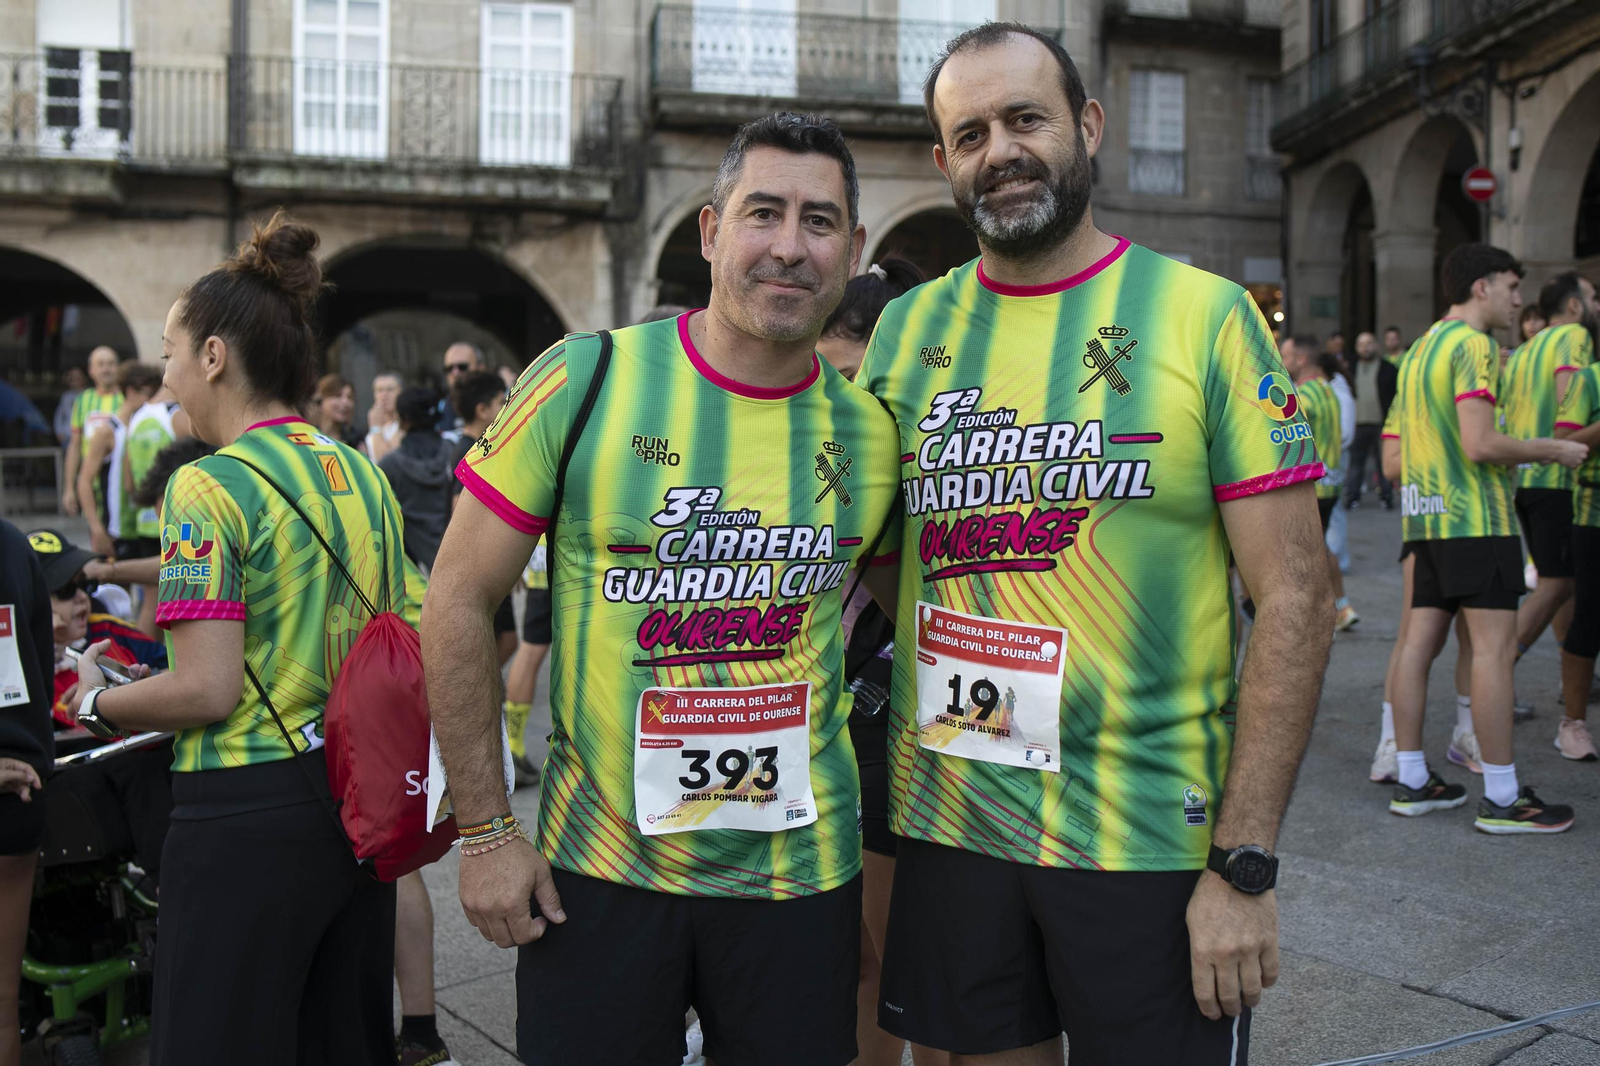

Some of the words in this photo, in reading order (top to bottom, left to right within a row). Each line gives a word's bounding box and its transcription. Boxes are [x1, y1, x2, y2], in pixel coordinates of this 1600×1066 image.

[919, 345, 947, 359] RUN
[925, 355, 952, 369] PRO
[956, 408, 1017, 430] EDICIÓN
[631, 434, 669, 452] RUN
[918, 419, 1104, 471] CARRERA
[643, 449, 681, 467] PRO
[1040, 460, 1154, 501] CIVIL
[699, 508, 760, 527] EDICIÓN
[656, 525, 835, 564] CARRERA
[918, 505, 1091, 567] OURENSE
[602, 563, 774, 603] GUARDIA
[779, 558, 852, 599] CIVIL
[636, 600, 810, 651] OURENSE
[935, 617, 944, 628] III
[946, 620, 984, 638] CARRERA
[986, 629, 1006, 642] DEL
[1007, 632, 1041, 646] PILAR
[927, 630, 960, 648] GUARDIA
[960, 639, 984, 653] CIVIL
[986, 645, 999, 656] DE
[676, 697, 688, 709] III
[694, 697, 746, 709] CARRERA
[748, 696, 765, 707] DEL
[767, 693, 793, 705] PILAR
[946, 673, 1000, 721] 19
[662, 712, 715, 724] GUARDIA
[717, 712, 747, 724] CIVIL
[749, 711, 761, 723] DE
[763, 705, 802, 720] OURENSE
[935, 714, 957, 729] CARLOS
[958, 720, 976, 733] SOTO
[977, 724, 1011, 738] ALVAREZ
[678, 746, 779, 791] 393
[681, 793, 712, 802] CARLOS
[713, 793, 749, 803] POMBAR
[750, 792, 779, 803] VIGARA
